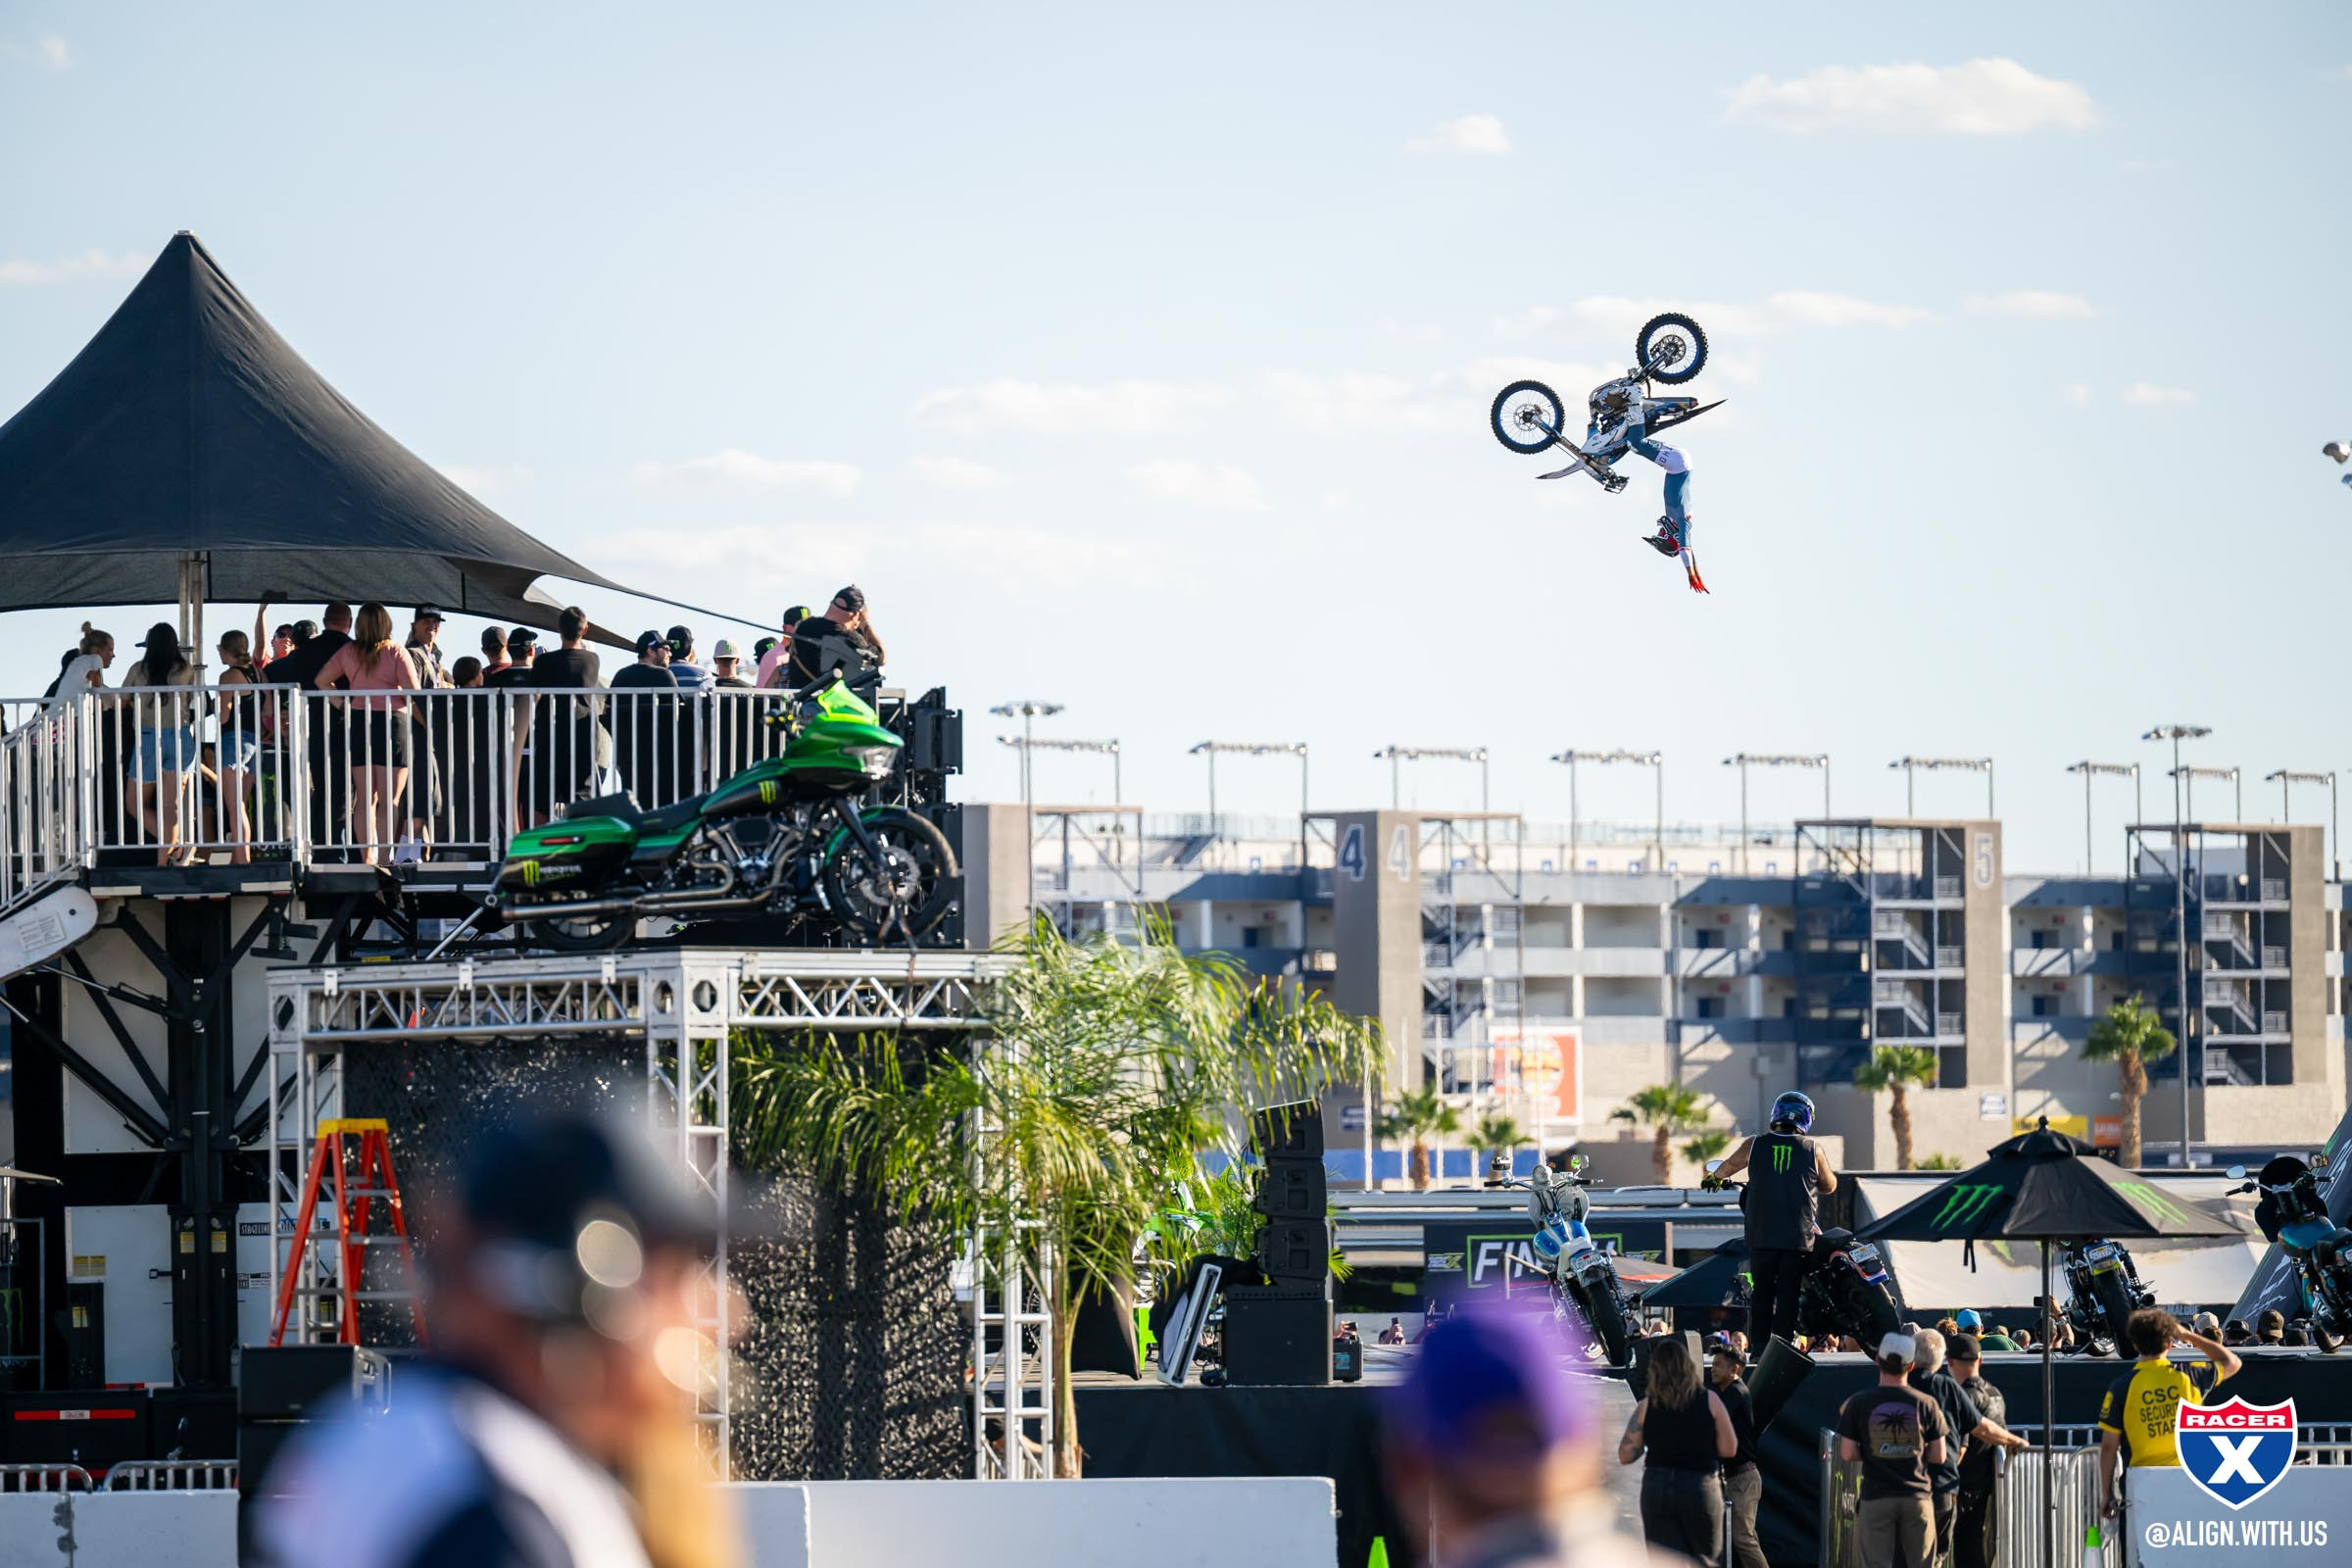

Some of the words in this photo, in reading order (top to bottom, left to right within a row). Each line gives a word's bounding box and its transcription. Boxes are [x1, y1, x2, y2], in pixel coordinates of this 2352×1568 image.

[1338, 824, 1365, 882] 4
[1388, 824, 1411, 882] 4
[1974, 833, 1994, 890] 5
[2141, 1385, 2180, 1405] CSC
[2147, 1418, 2176, 1439] STAF
